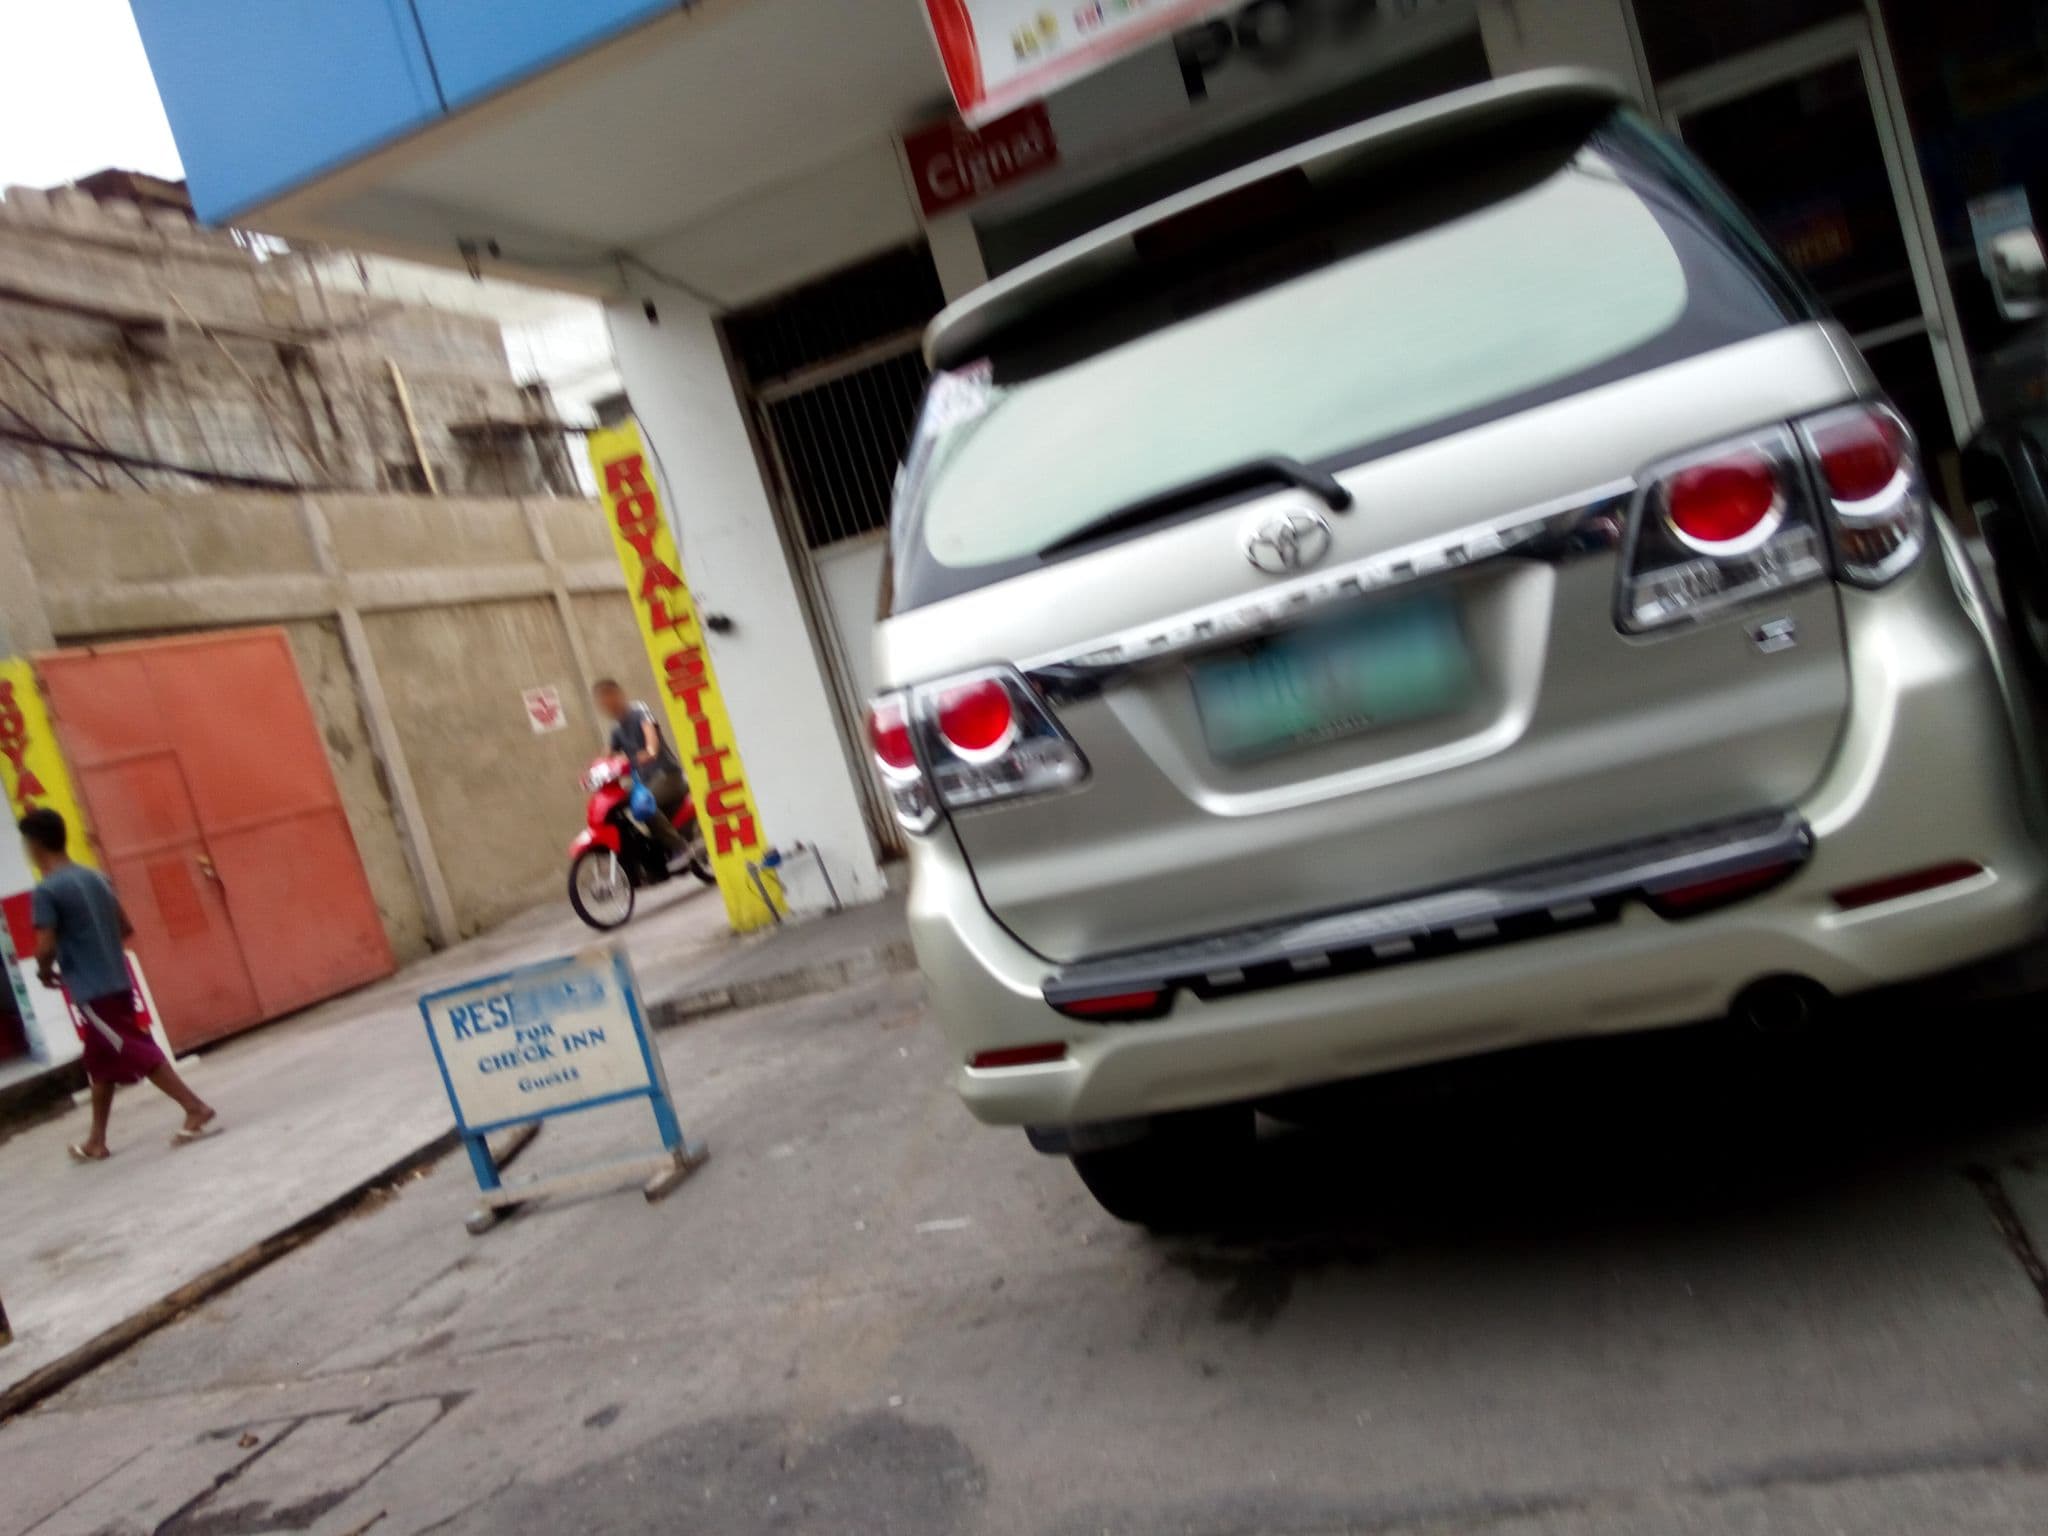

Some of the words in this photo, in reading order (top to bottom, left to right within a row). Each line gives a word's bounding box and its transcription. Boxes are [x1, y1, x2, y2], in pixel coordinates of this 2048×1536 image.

[604, 455, 690, 632] ROYAL
[664, 646, 758, 856] STITCH
[478, 1044, 556, 1074] CHECK
[562, 1028, 606, 1052] INN
[516, 1024, 555, 1043] FOR
